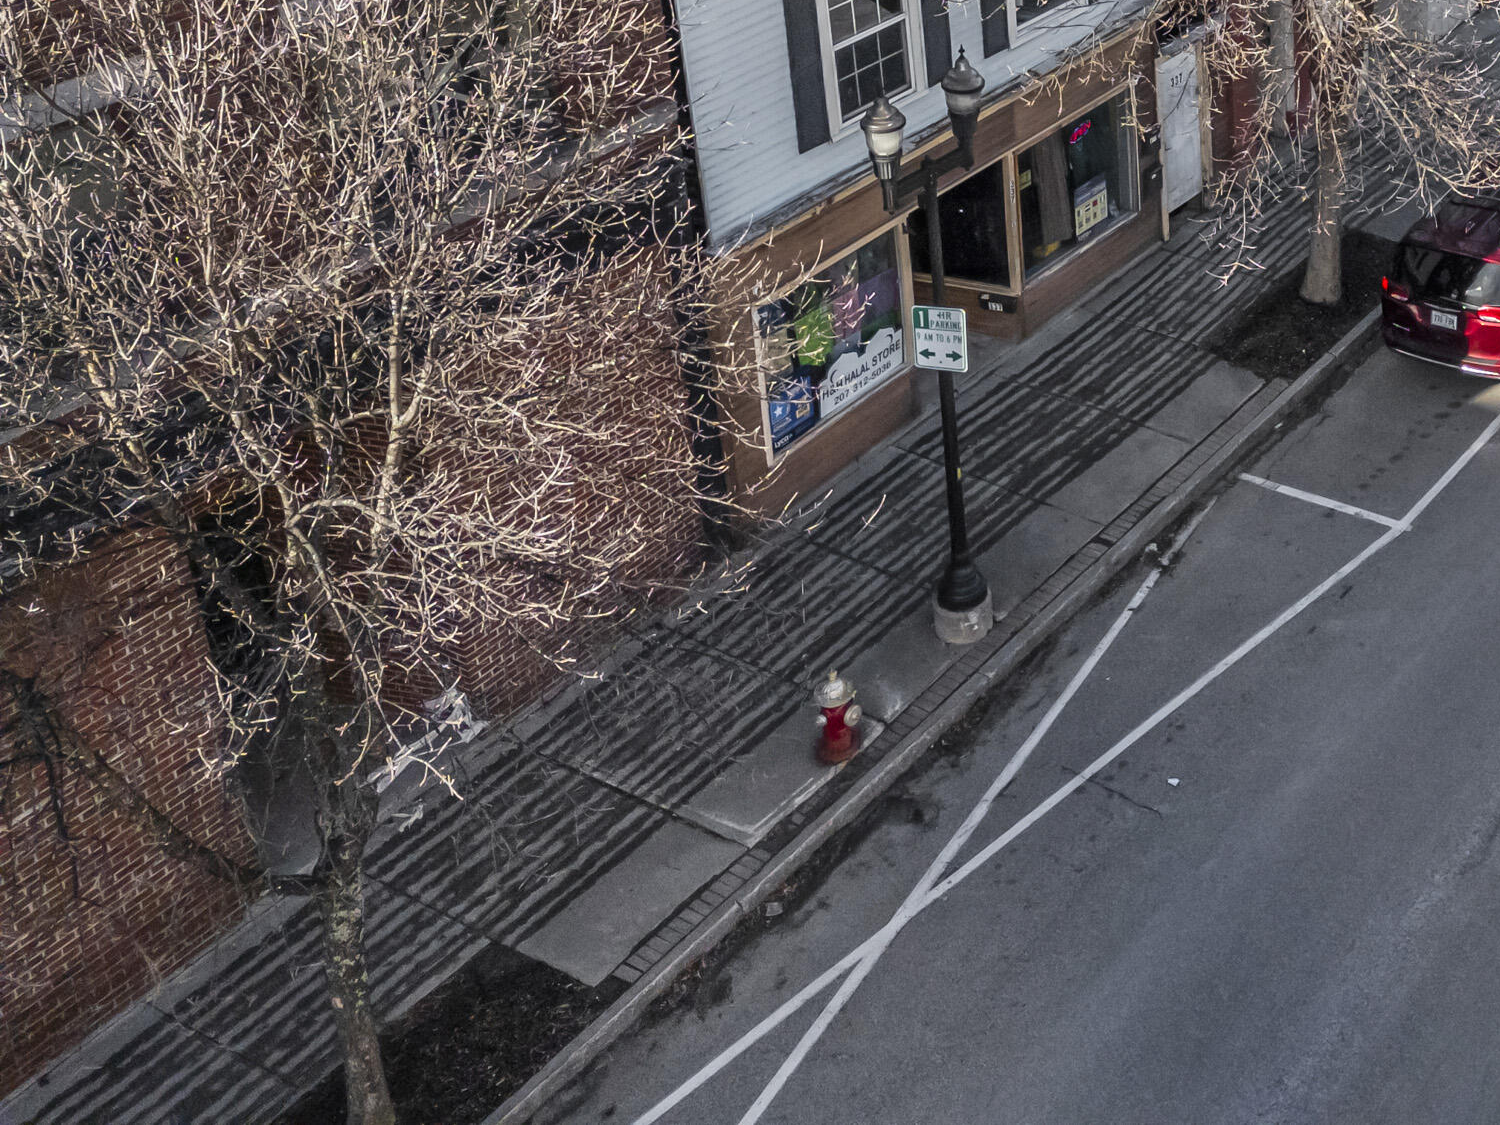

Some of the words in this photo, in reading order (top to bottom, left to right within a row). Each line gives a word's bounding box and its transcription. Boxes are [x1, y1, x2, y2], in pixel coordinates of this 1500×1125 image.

[1171, 72, 1182, 87] 337
[918, 310, 924, 327] 1
[939, 312, 952, 320] HR
[930, 320, 962, 330] PARKING
[924, 333, 933, 342] AM
[936, 334, 944, 342] TO
[953, 335, 963, 344] PM
[844, 361, 870, 386] HALAL
[872, 339, 901, 366] STORE
